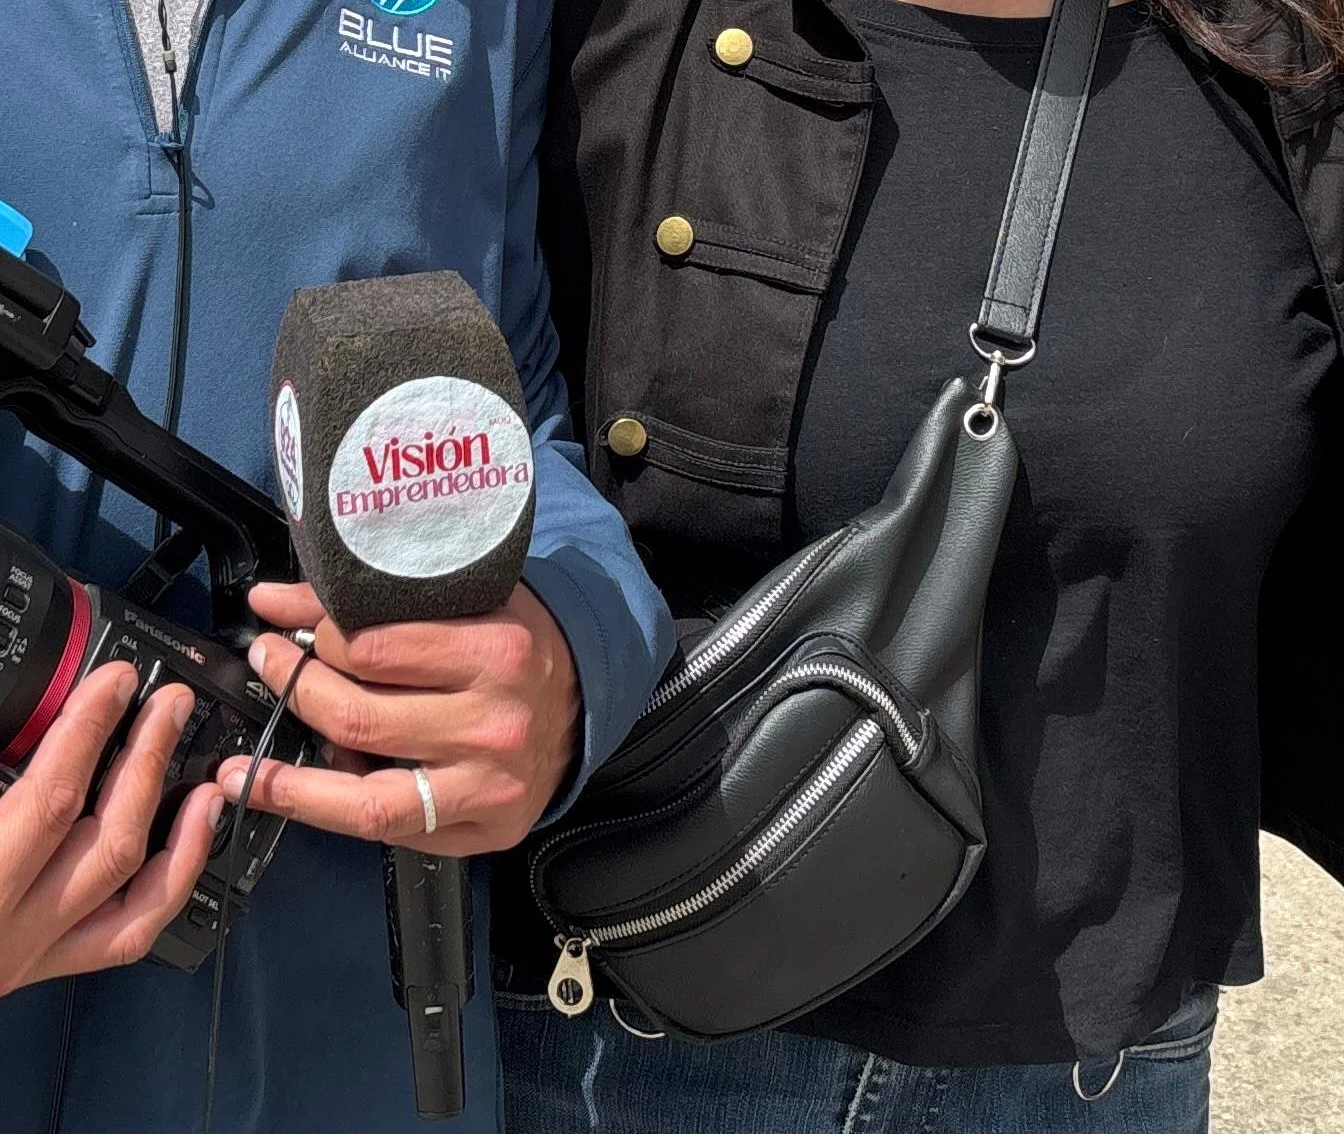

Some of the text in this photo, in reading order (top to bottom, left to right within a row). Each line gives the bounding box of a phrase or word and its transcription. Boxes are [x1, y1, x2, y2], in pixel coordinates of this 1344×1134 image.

[338, 8, 454, 66] BLUE
[339, 40, 452, 82] ALLIANCE IT
[363, 426, 491, 484] Visión
[336, 462, 529, 517] Emprendedora
[10, 566, 34, 584] FOCUS
[124, 609, 206, 666] Panasonic
